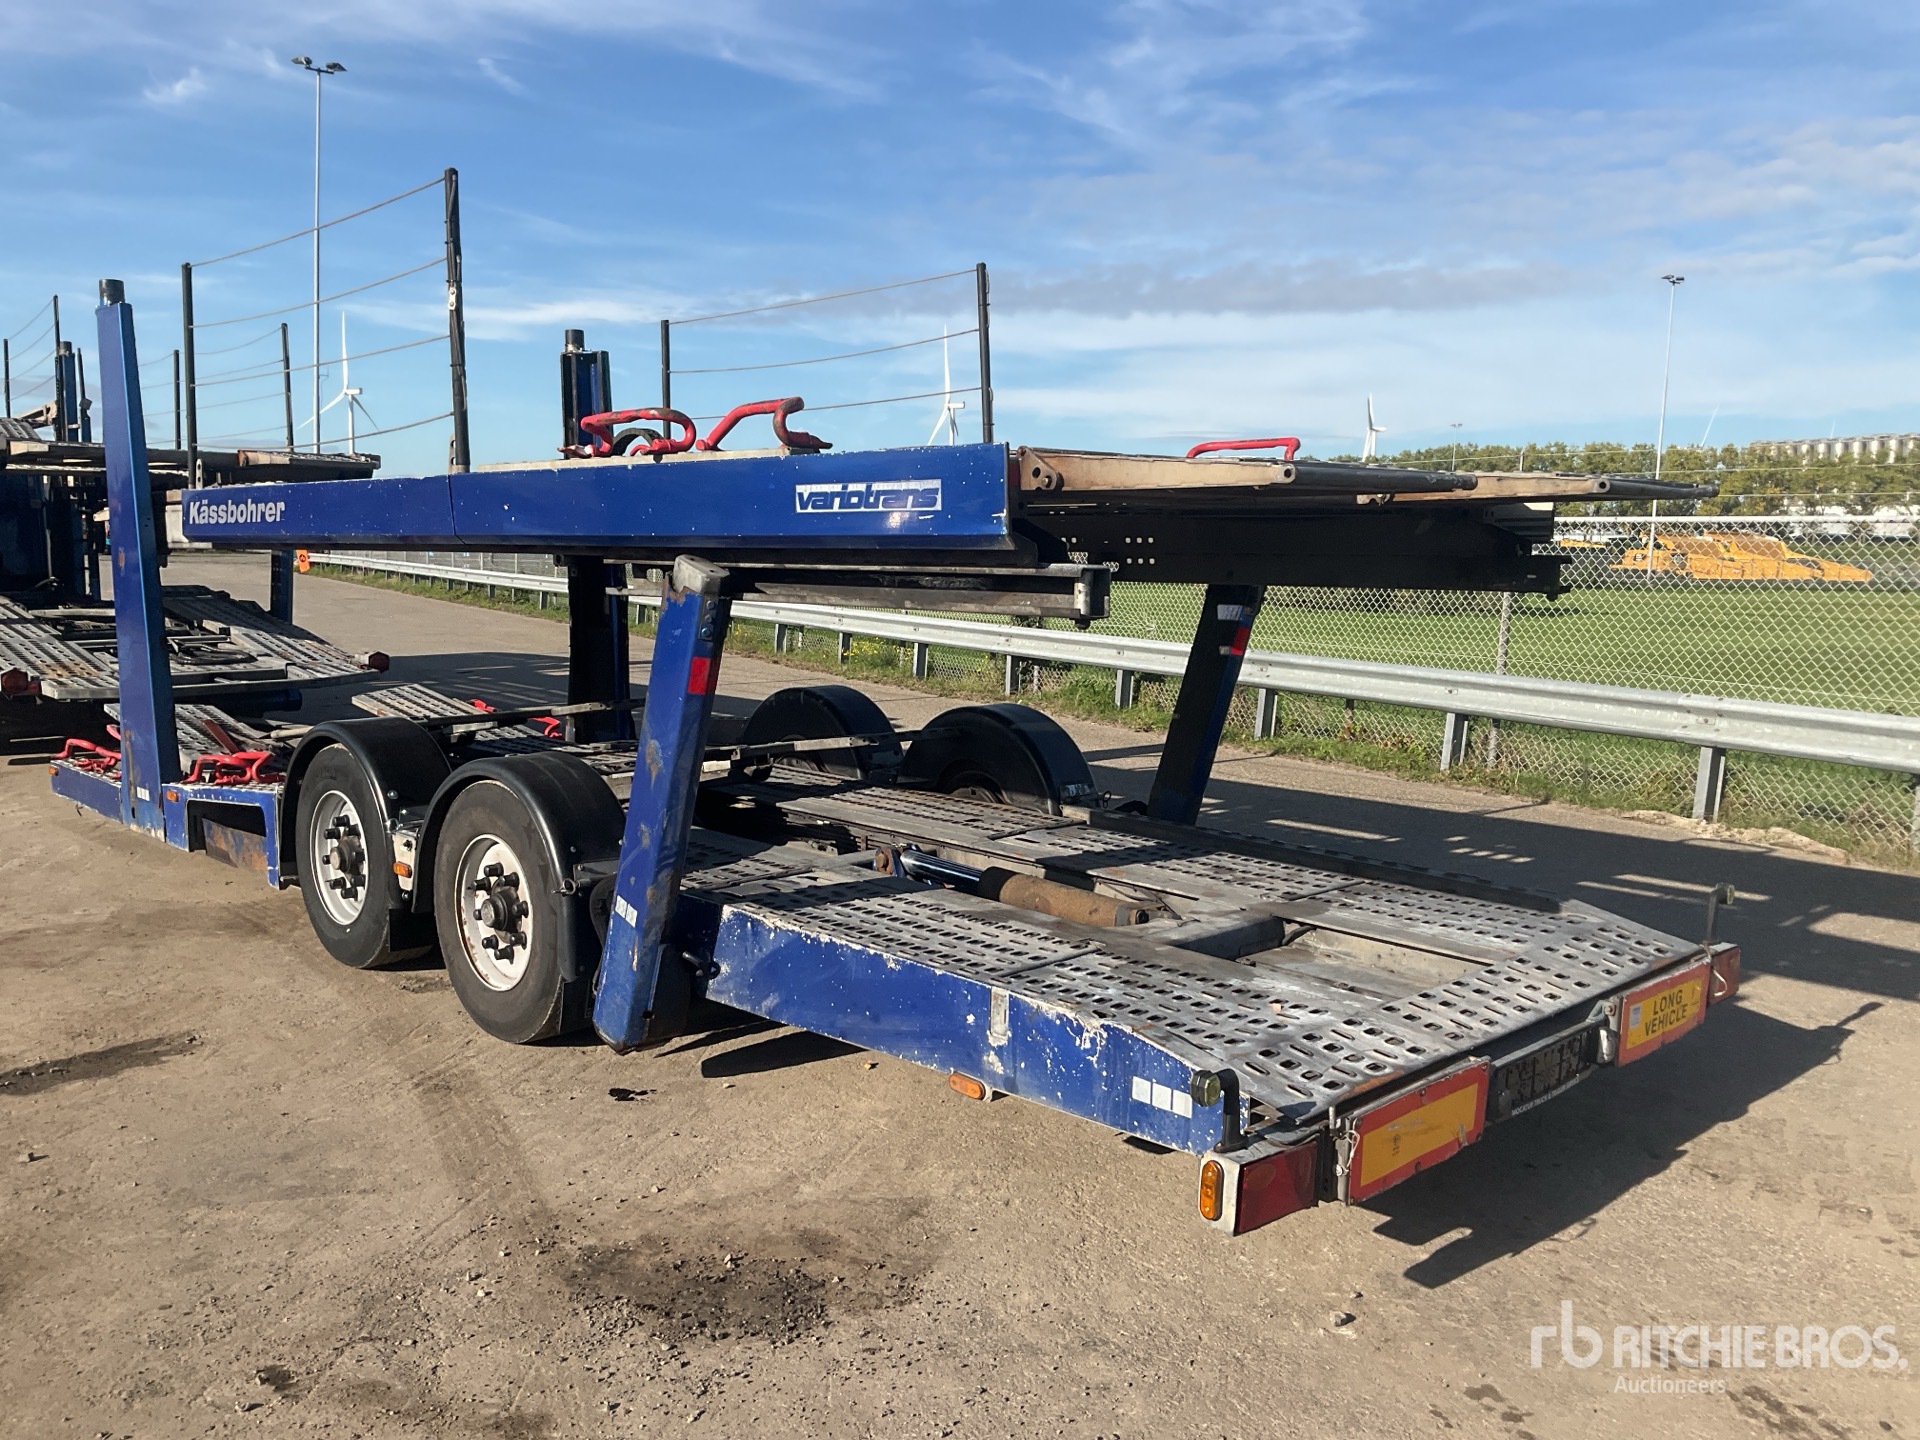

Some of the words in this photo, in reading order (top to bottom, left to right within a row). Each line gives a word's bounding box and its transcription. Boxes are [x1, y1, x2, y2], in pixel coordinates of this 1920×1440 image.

[189, 498, 286, 524] Kässbohrer
[1652, 989, 1684, 1016] LONG
[1644, 1003, 1688, 1037] VEHICLE
